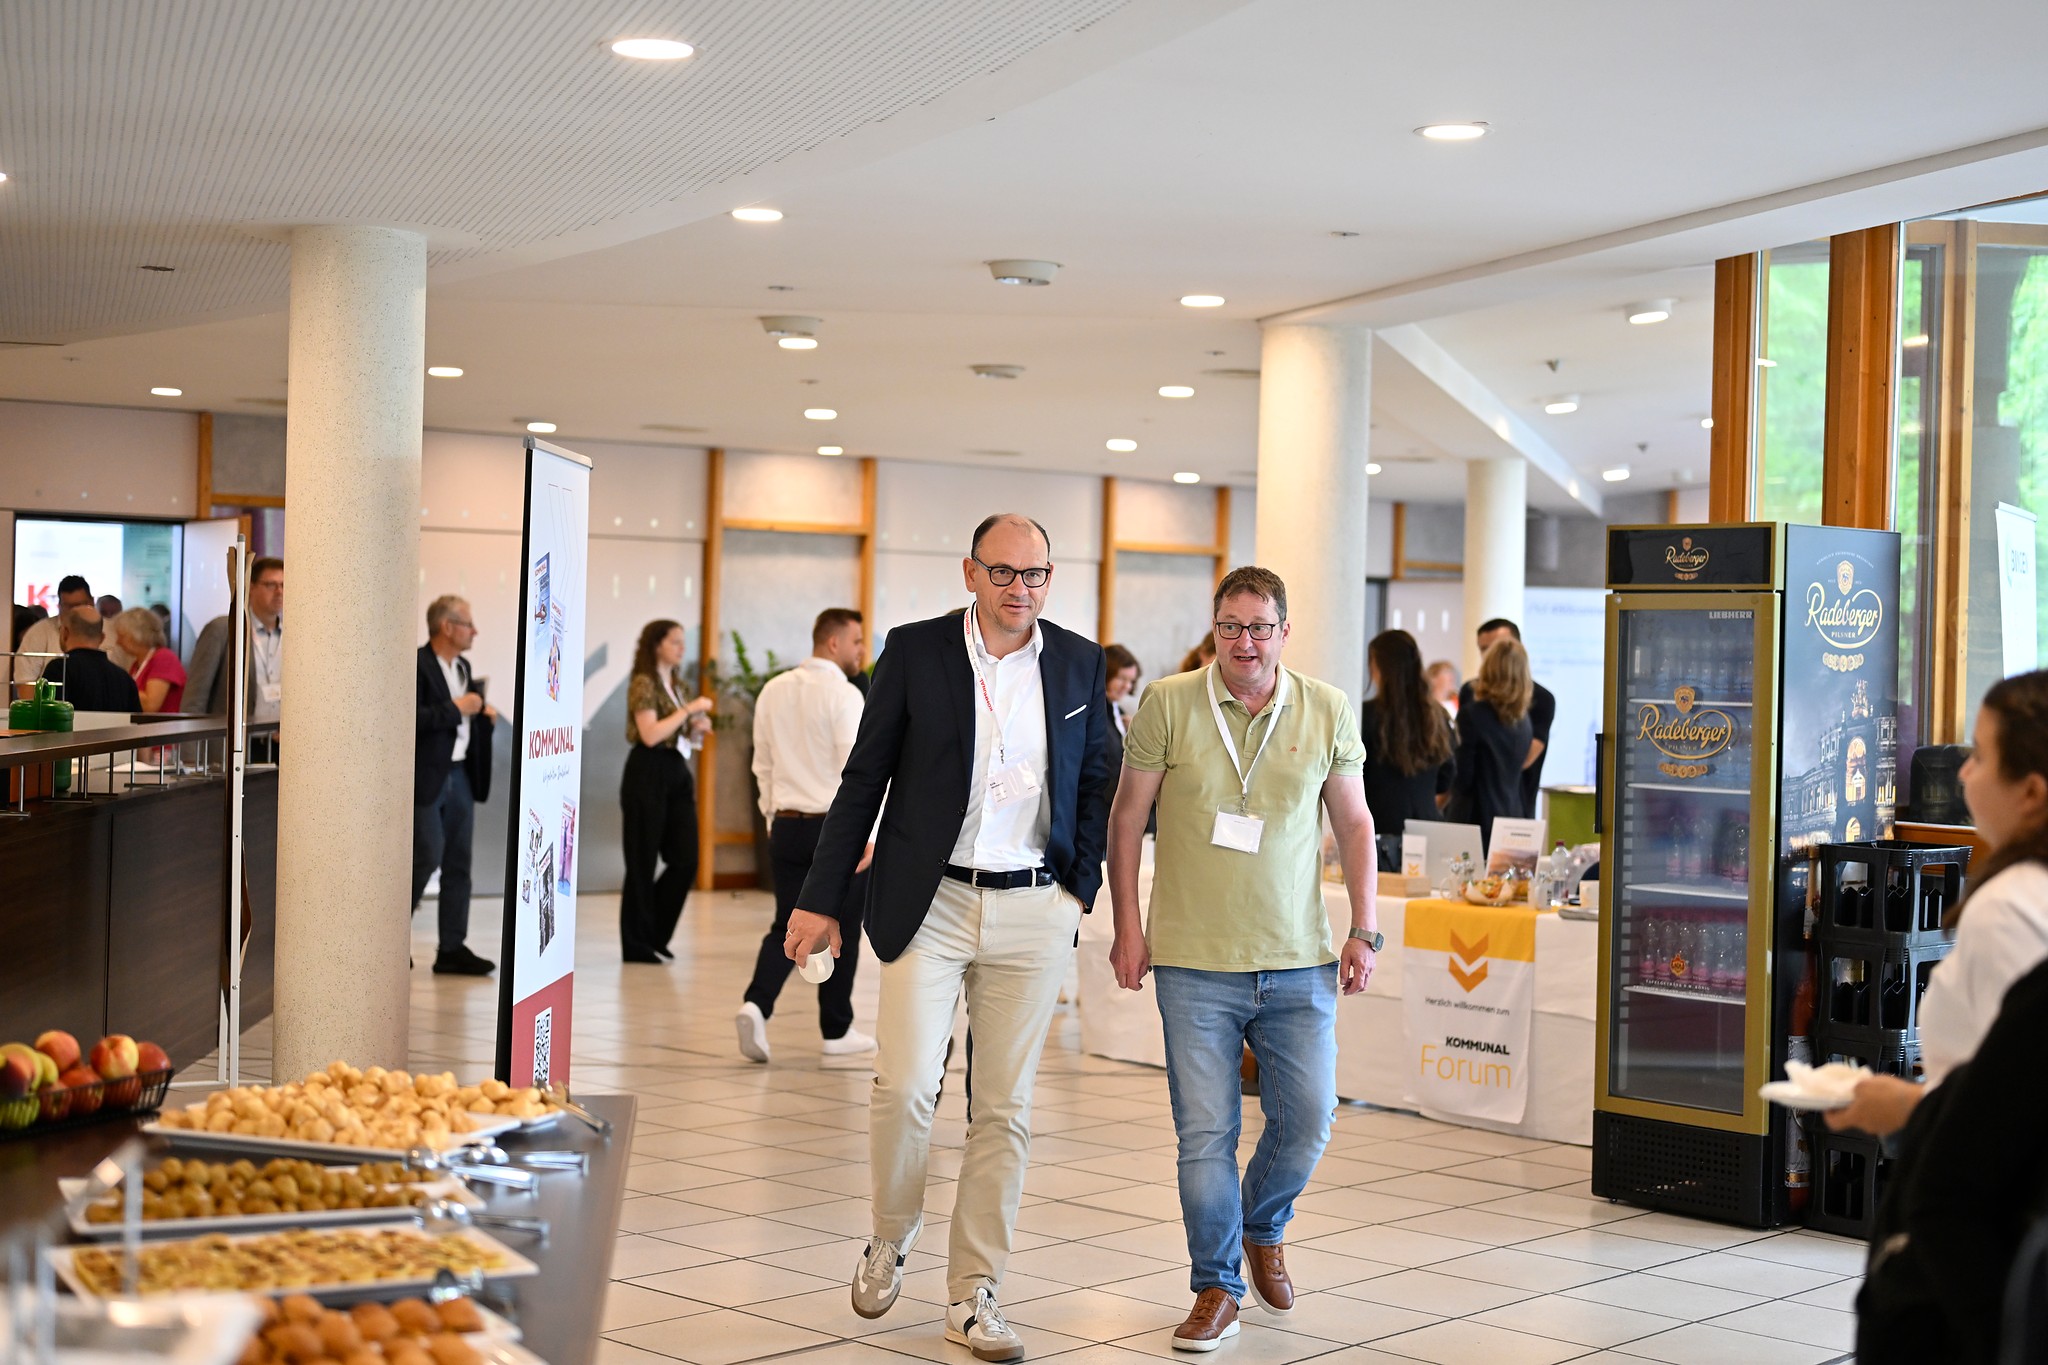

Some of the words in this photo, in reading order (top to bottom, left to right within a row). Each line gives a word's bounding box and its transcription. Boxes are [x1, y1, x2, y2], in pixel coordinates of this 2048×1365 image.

[1664, 545, 1709, 571] Radeberger
[1709, 611, 1753, 619] LIEBHERR
[1805, 582, 1882, 649] Radeberger
[529, 725, 574, 760] KOMMUNAL
[1636, 704, 1732, 760] Radeberger
[1425, 997, 1452, 1008] Herzlich
[1454, 1002, 1495, 1013] willkommen
[1496, 1008, 1510, 1016] zum
[1445, 1036, 1510, 1055] KOMMUNAL
[1421, 1044, 1511, 1088] Forum
